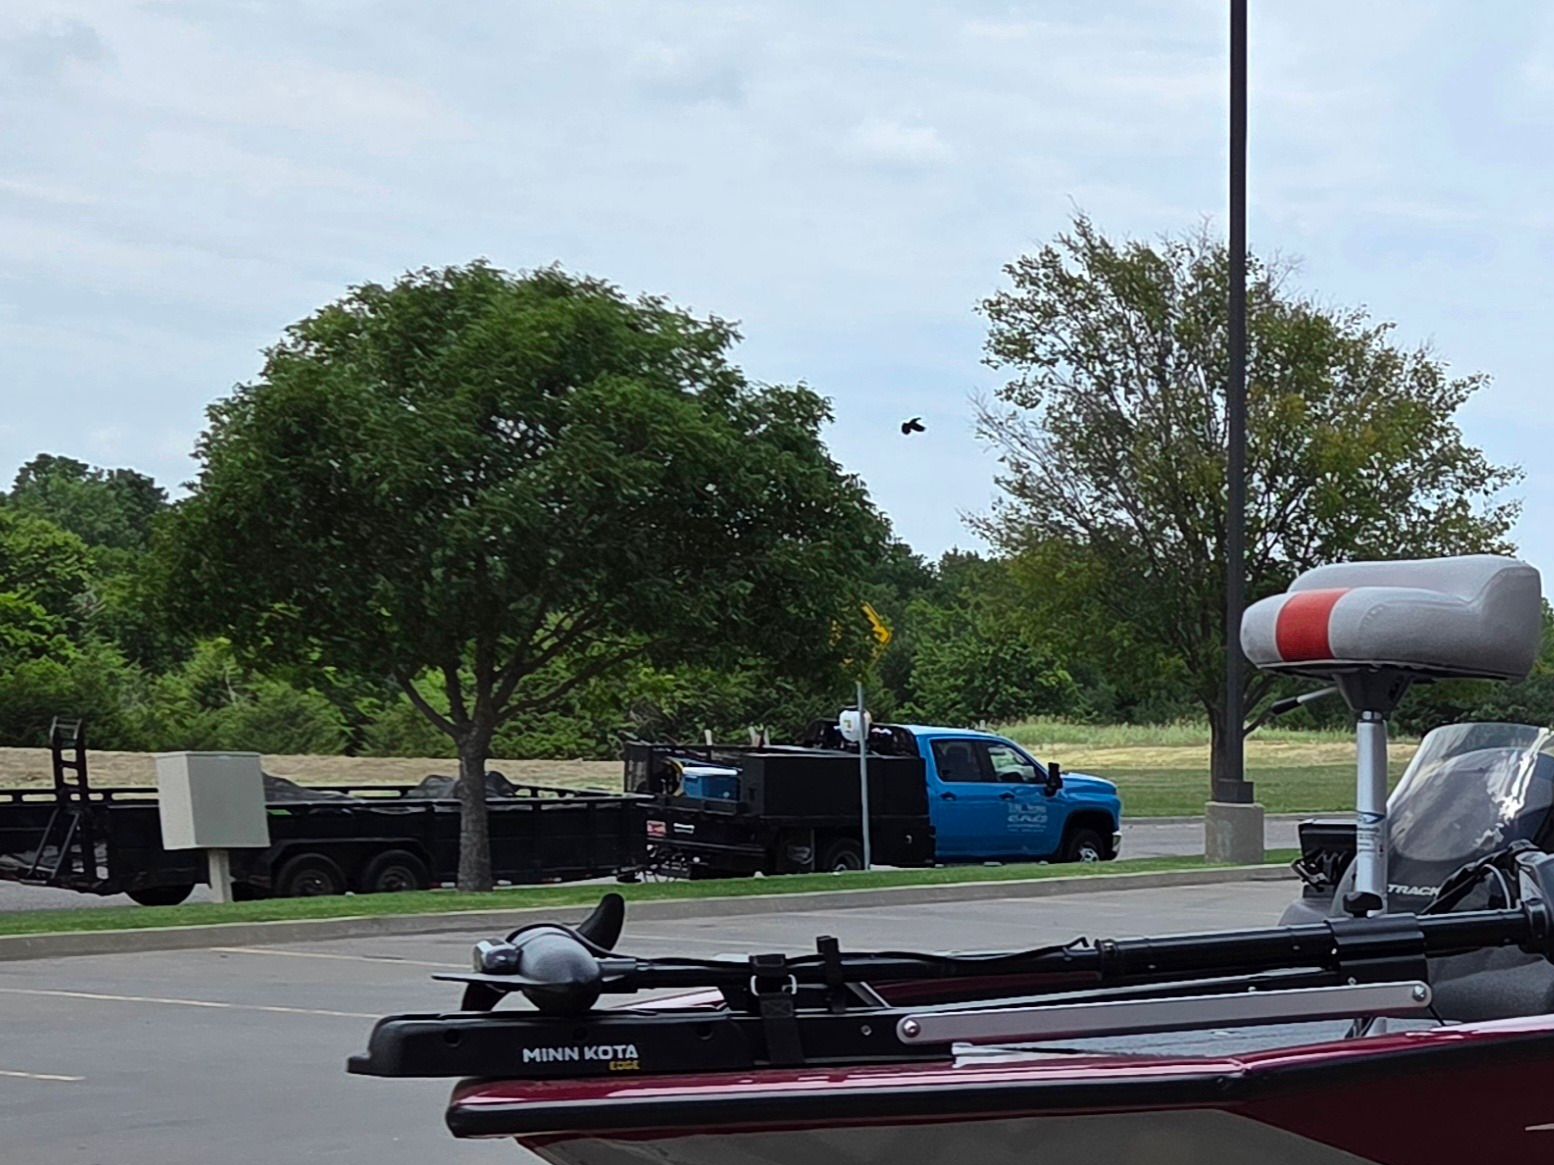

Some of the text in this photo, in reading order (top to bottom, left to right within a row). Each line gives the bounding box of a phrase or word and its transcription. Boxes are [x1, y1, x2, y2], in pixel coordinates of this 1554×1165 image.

[1388, 884, 1441, 896] TRACK
[523, 1044, 639, 1063] MINN KOTA
